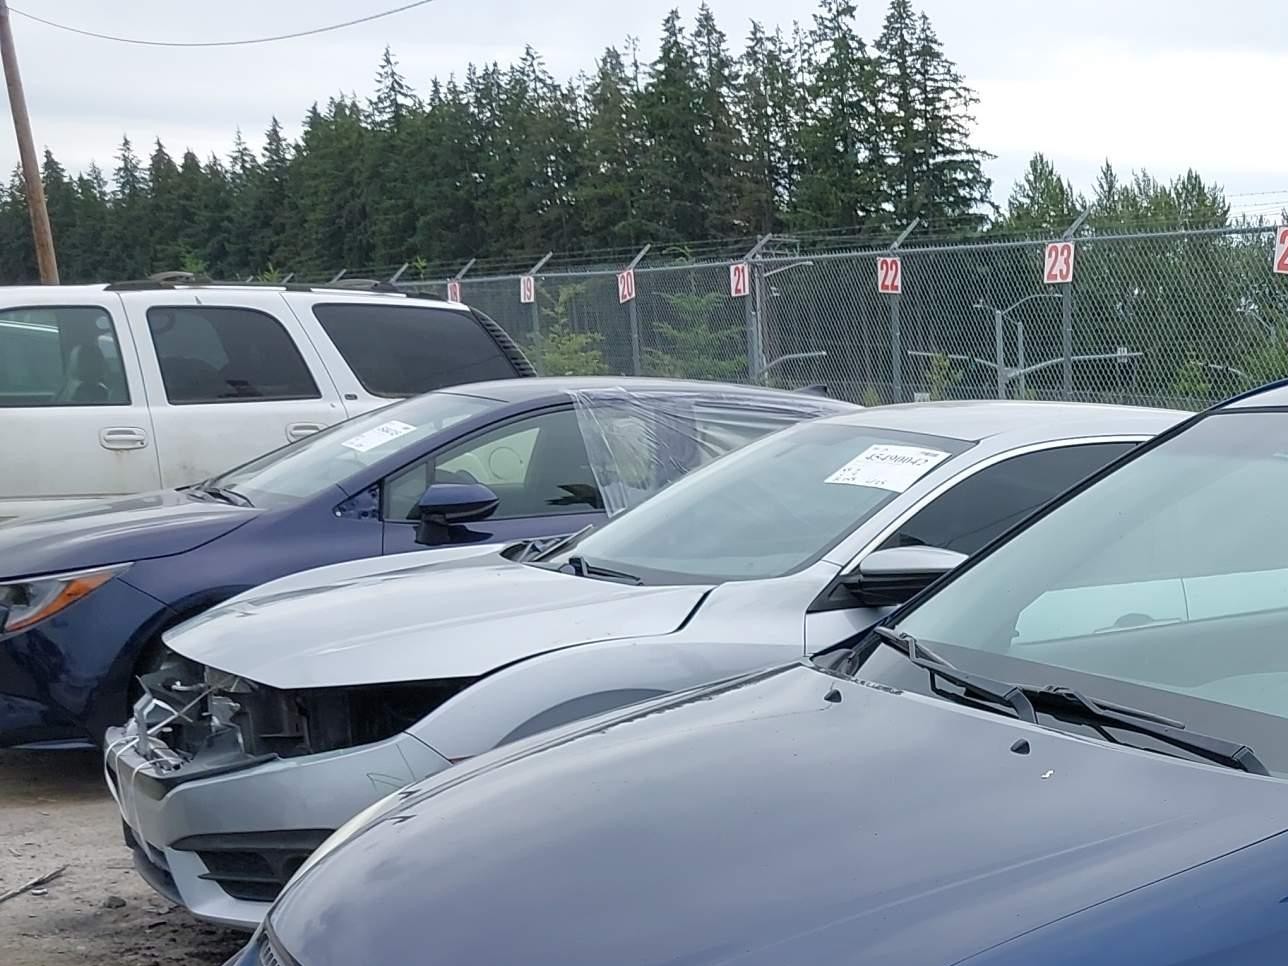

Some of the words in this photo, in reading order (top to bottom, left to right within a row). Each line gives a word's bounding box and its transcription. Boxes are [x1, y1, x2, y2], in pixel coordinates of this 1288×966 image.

[880, 259, 899, 291] 22
[1046, 244, 1072, 282] 23
[523, 278, 532, 300] 19
[620, 271, 634, 301] 20
[734, 267, 747, 294] 21
